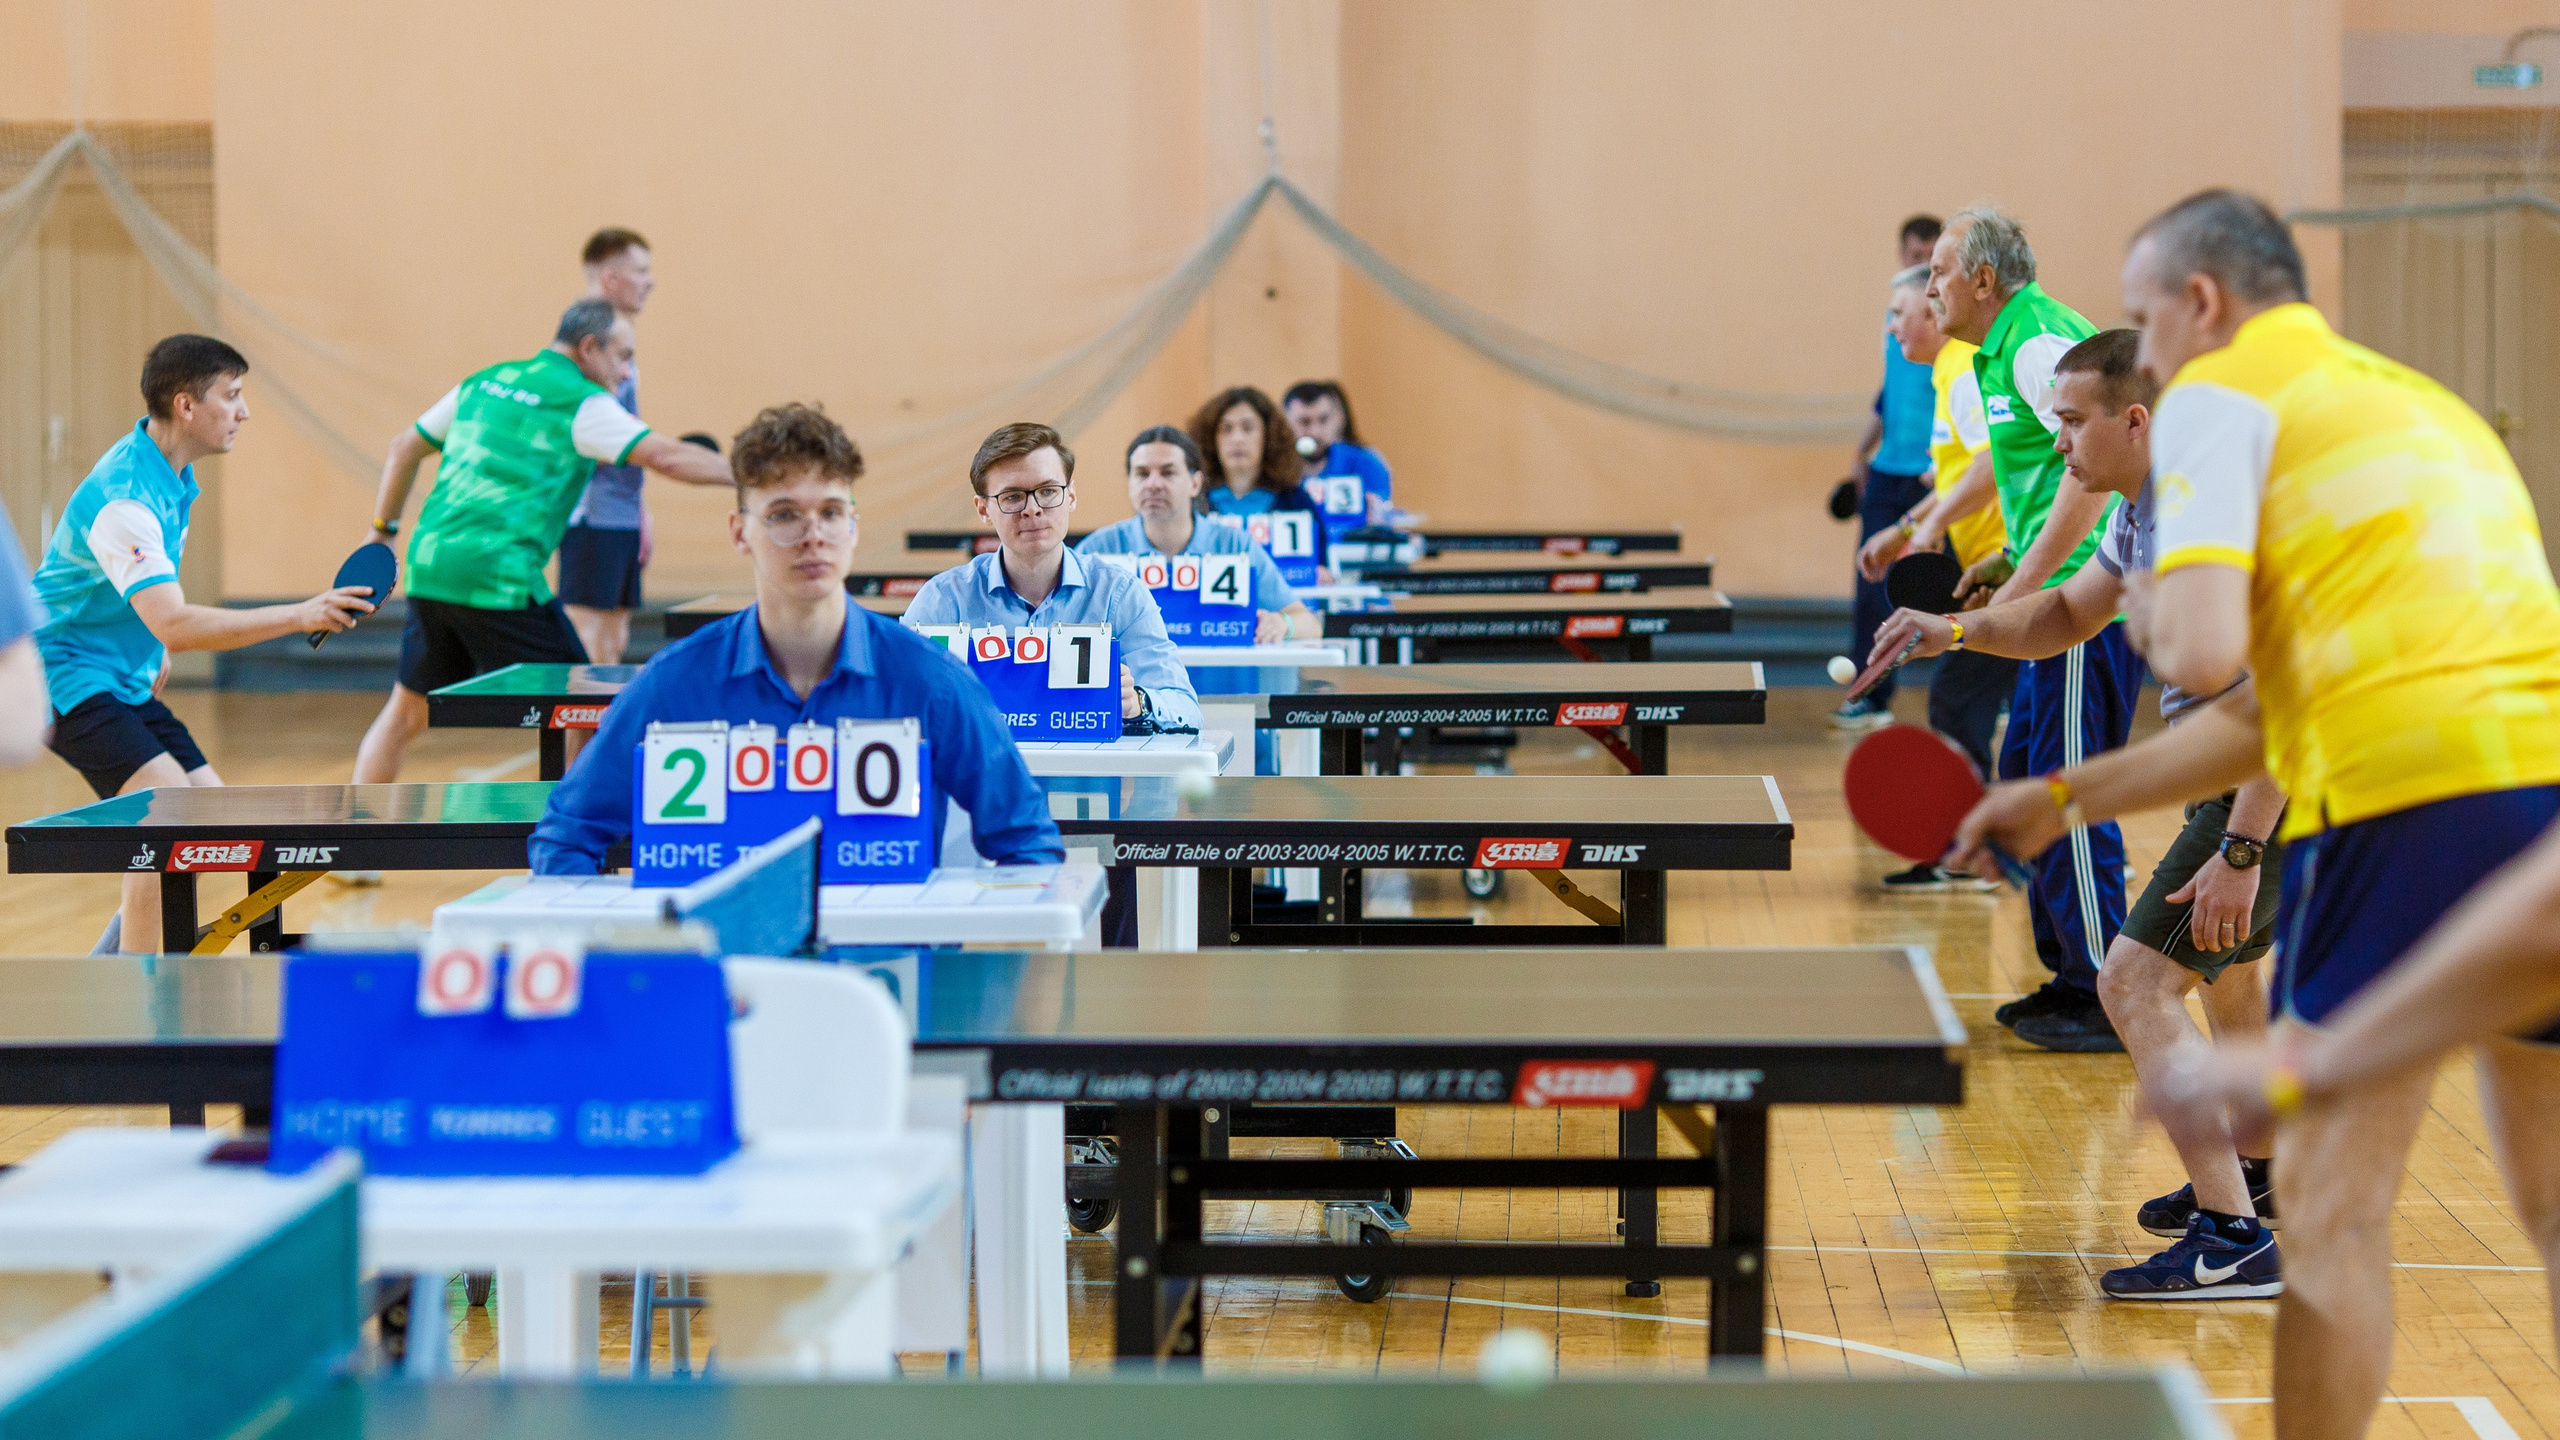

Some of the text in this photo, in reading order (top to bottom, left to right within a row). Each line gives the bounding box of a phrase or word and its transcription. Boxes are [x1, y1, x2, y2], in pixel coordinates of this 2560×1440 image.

[1285, 521, 1298, 551] 1
[1144, 565, 1239, 601] 0 0 4
[977, 636, 1006, 659] 0
[1017, 636, 1045, 661] 0
[1070, 636, 1091, 684] 1
[1050, 711, 1111, 729] GUEST
[1285, 710, 1327, 724] Official
[1331, 710, 1366, 724] Table
[1368, 709, 1383, 723] of
[1635, 706, 1685, 721] DHS
[660, 742, 900, 818] 2 0 0 0
[274, 846, 340, 864] DHS
[639, 842, 722, 869] HOME
[837, 840, 920, 867] GUEST
[1114, 843, 1171, 860] Official
[1174, 844, 1220, 860] Table
[1224, 844, 1246, 860] of
[1394, 844, 1465, 861] W.T.T.C.
[1580, 845, 1646, 862] DHS
[428, 947, 578, 1014] 0 0
